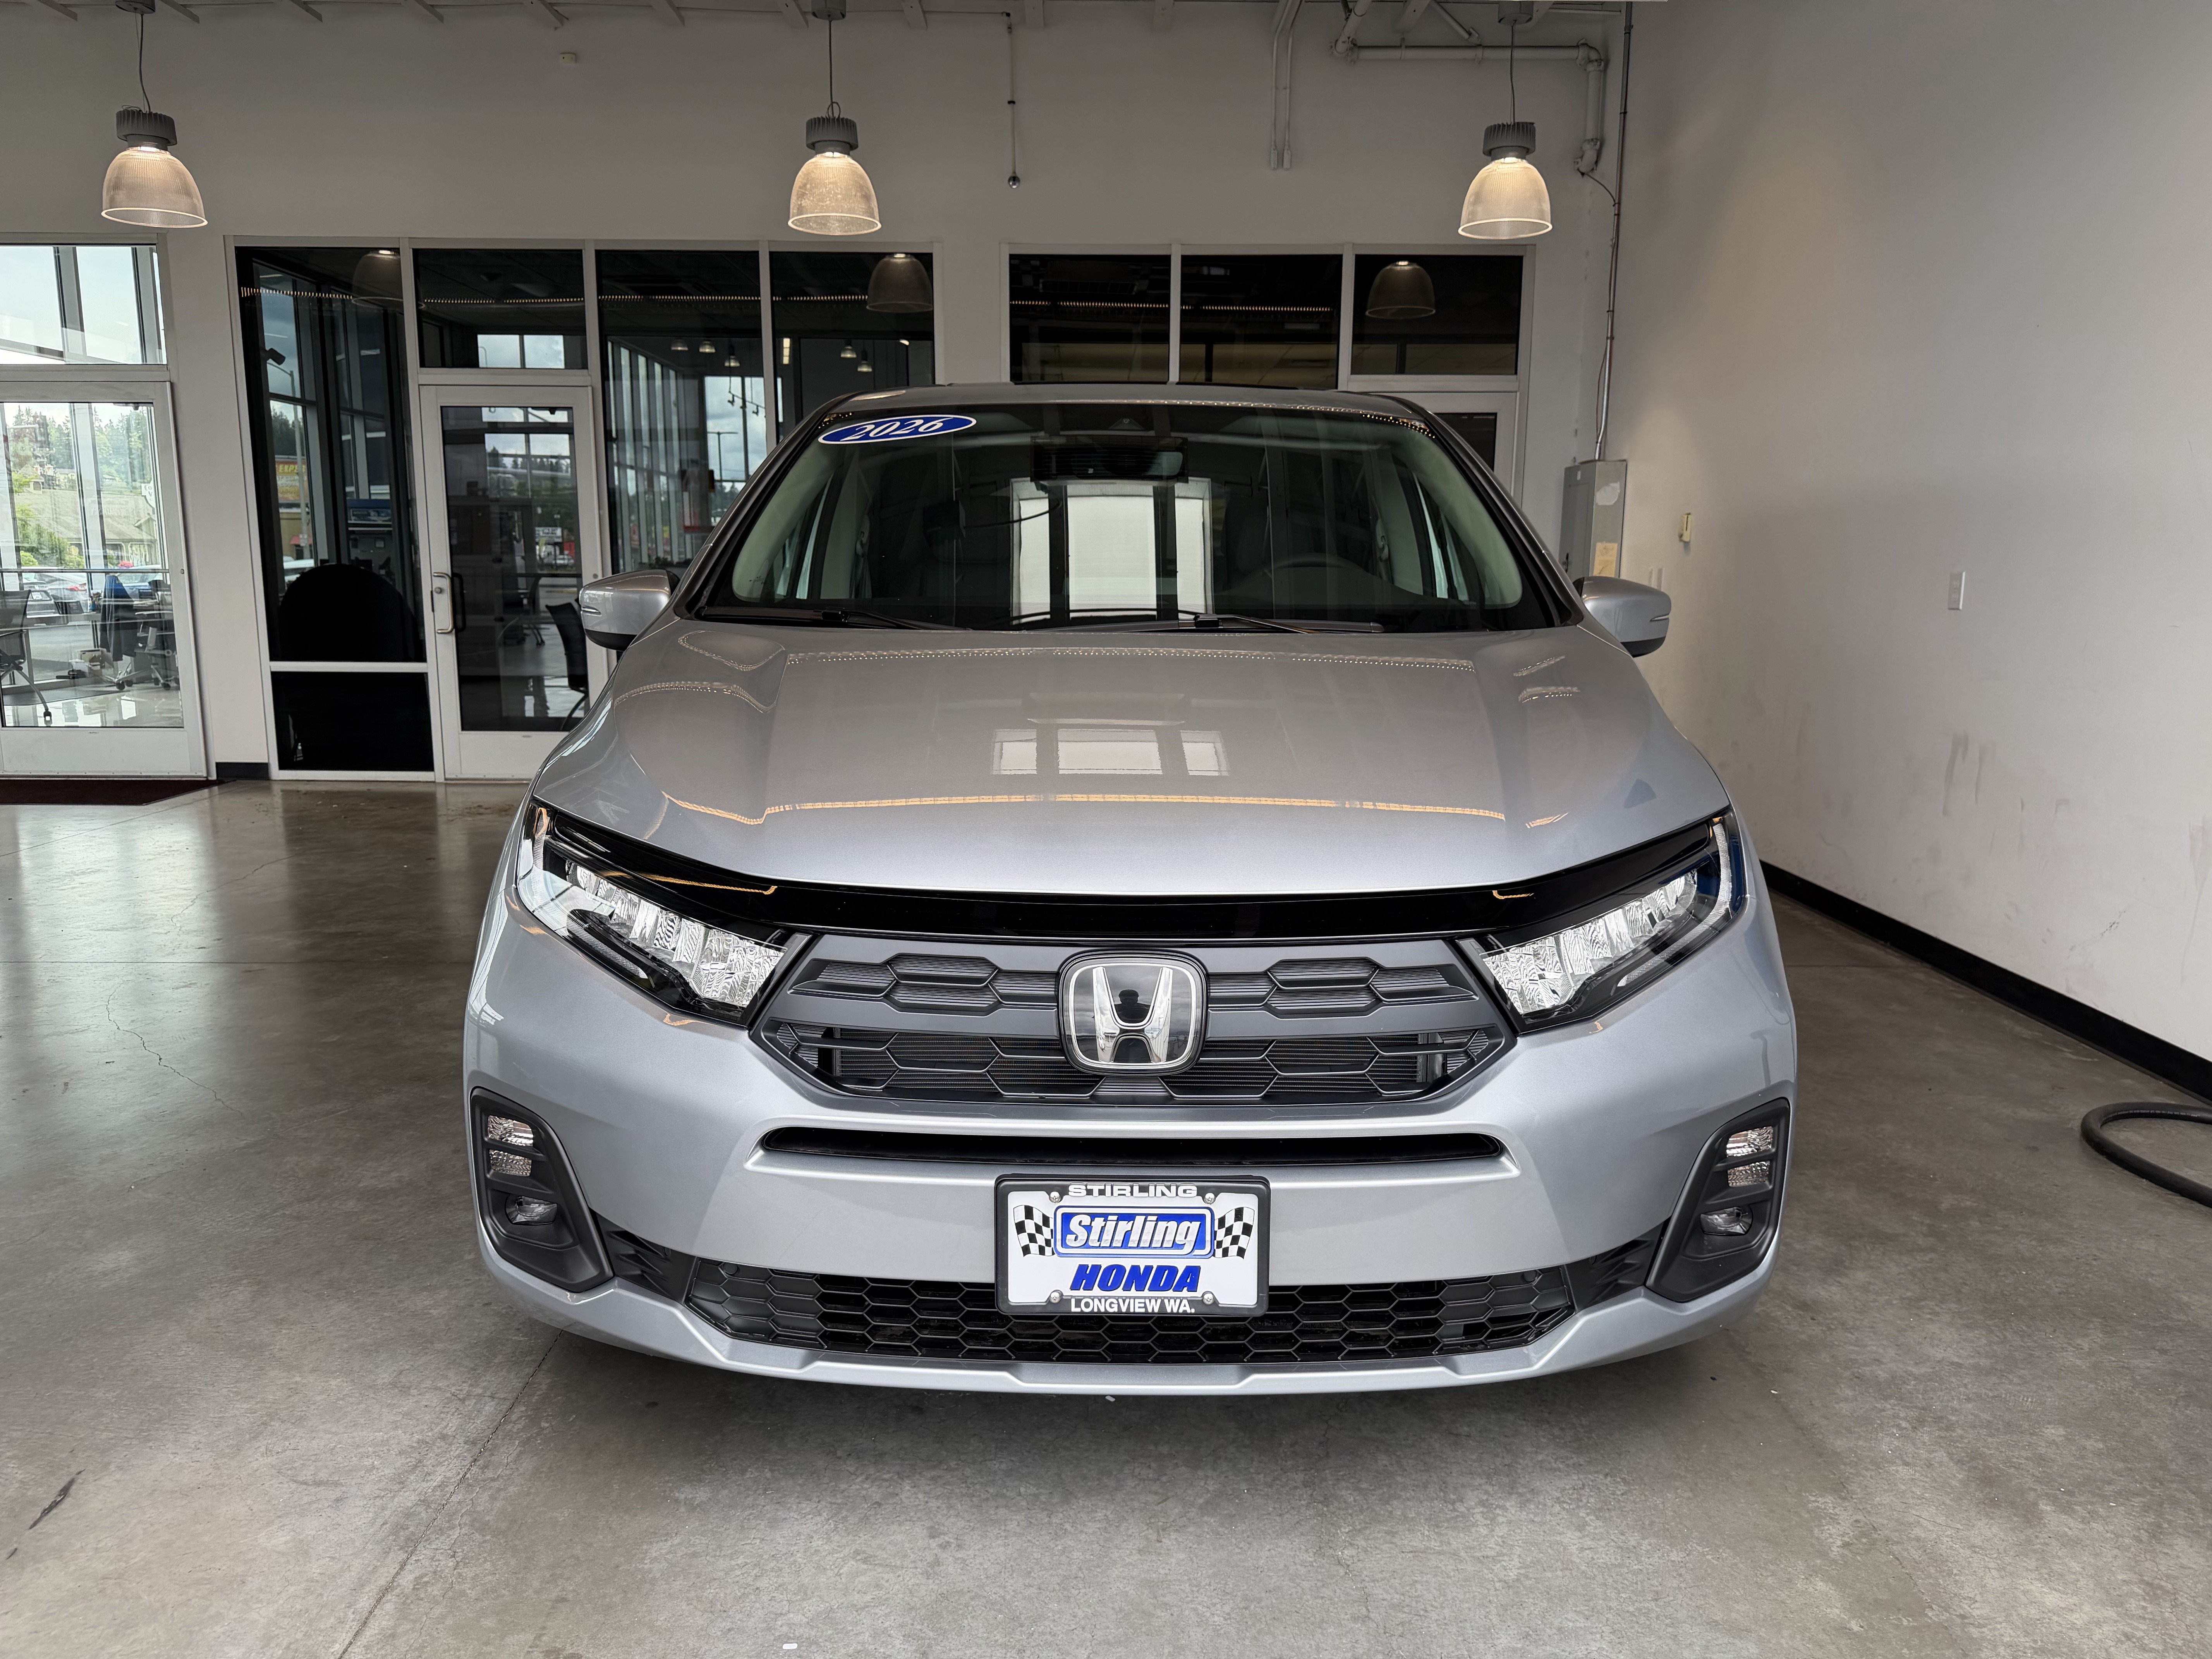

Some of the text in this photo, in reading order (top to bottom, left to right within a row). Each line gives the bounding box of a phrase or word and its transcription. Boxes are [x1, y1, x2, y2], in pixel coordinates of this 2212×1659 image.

[840, 417, 954, 442] 2026
[1068, 1183, 1198, 1197] STIRLING
[1066, 1214, 1201, 1255] Stirling
[1069, 1264, 1201, 1292] HONDA
[1071, 1298, 1195, 1313] LONGVIEW WA.
